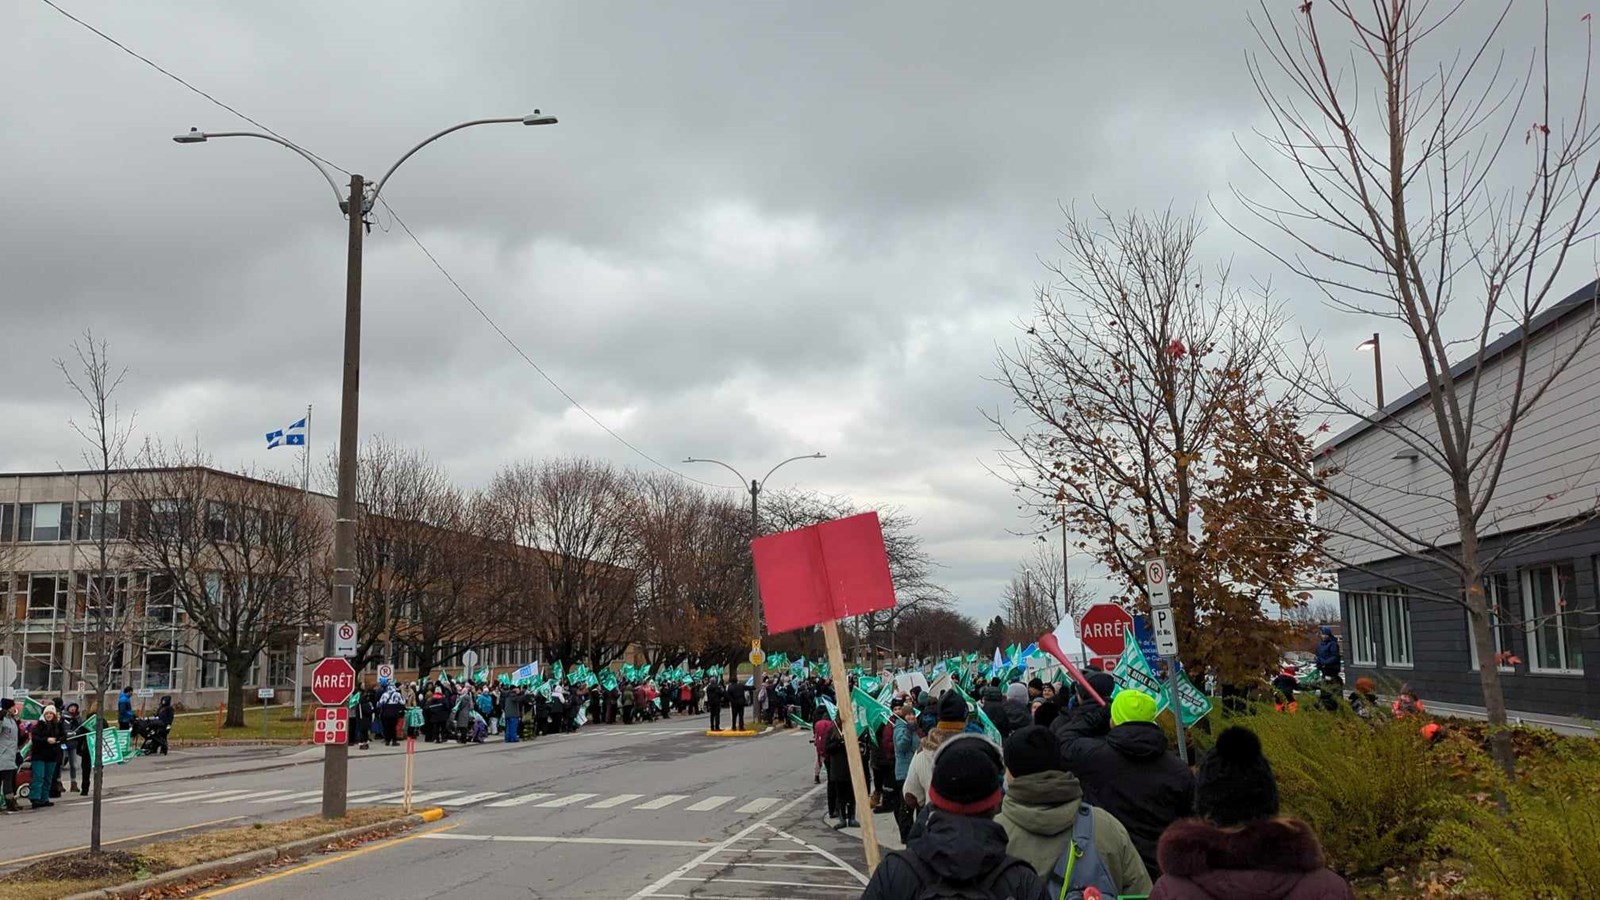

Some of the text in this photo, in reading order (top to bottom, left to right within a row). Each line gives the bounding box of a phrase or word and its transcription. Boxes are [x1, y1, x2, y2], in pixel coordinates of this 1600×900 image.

[1157, 611, 1167, 628] P
[1083, 619, 1131, 638] ARRÊT
[314, 672, 353, 688] ARRÊT
